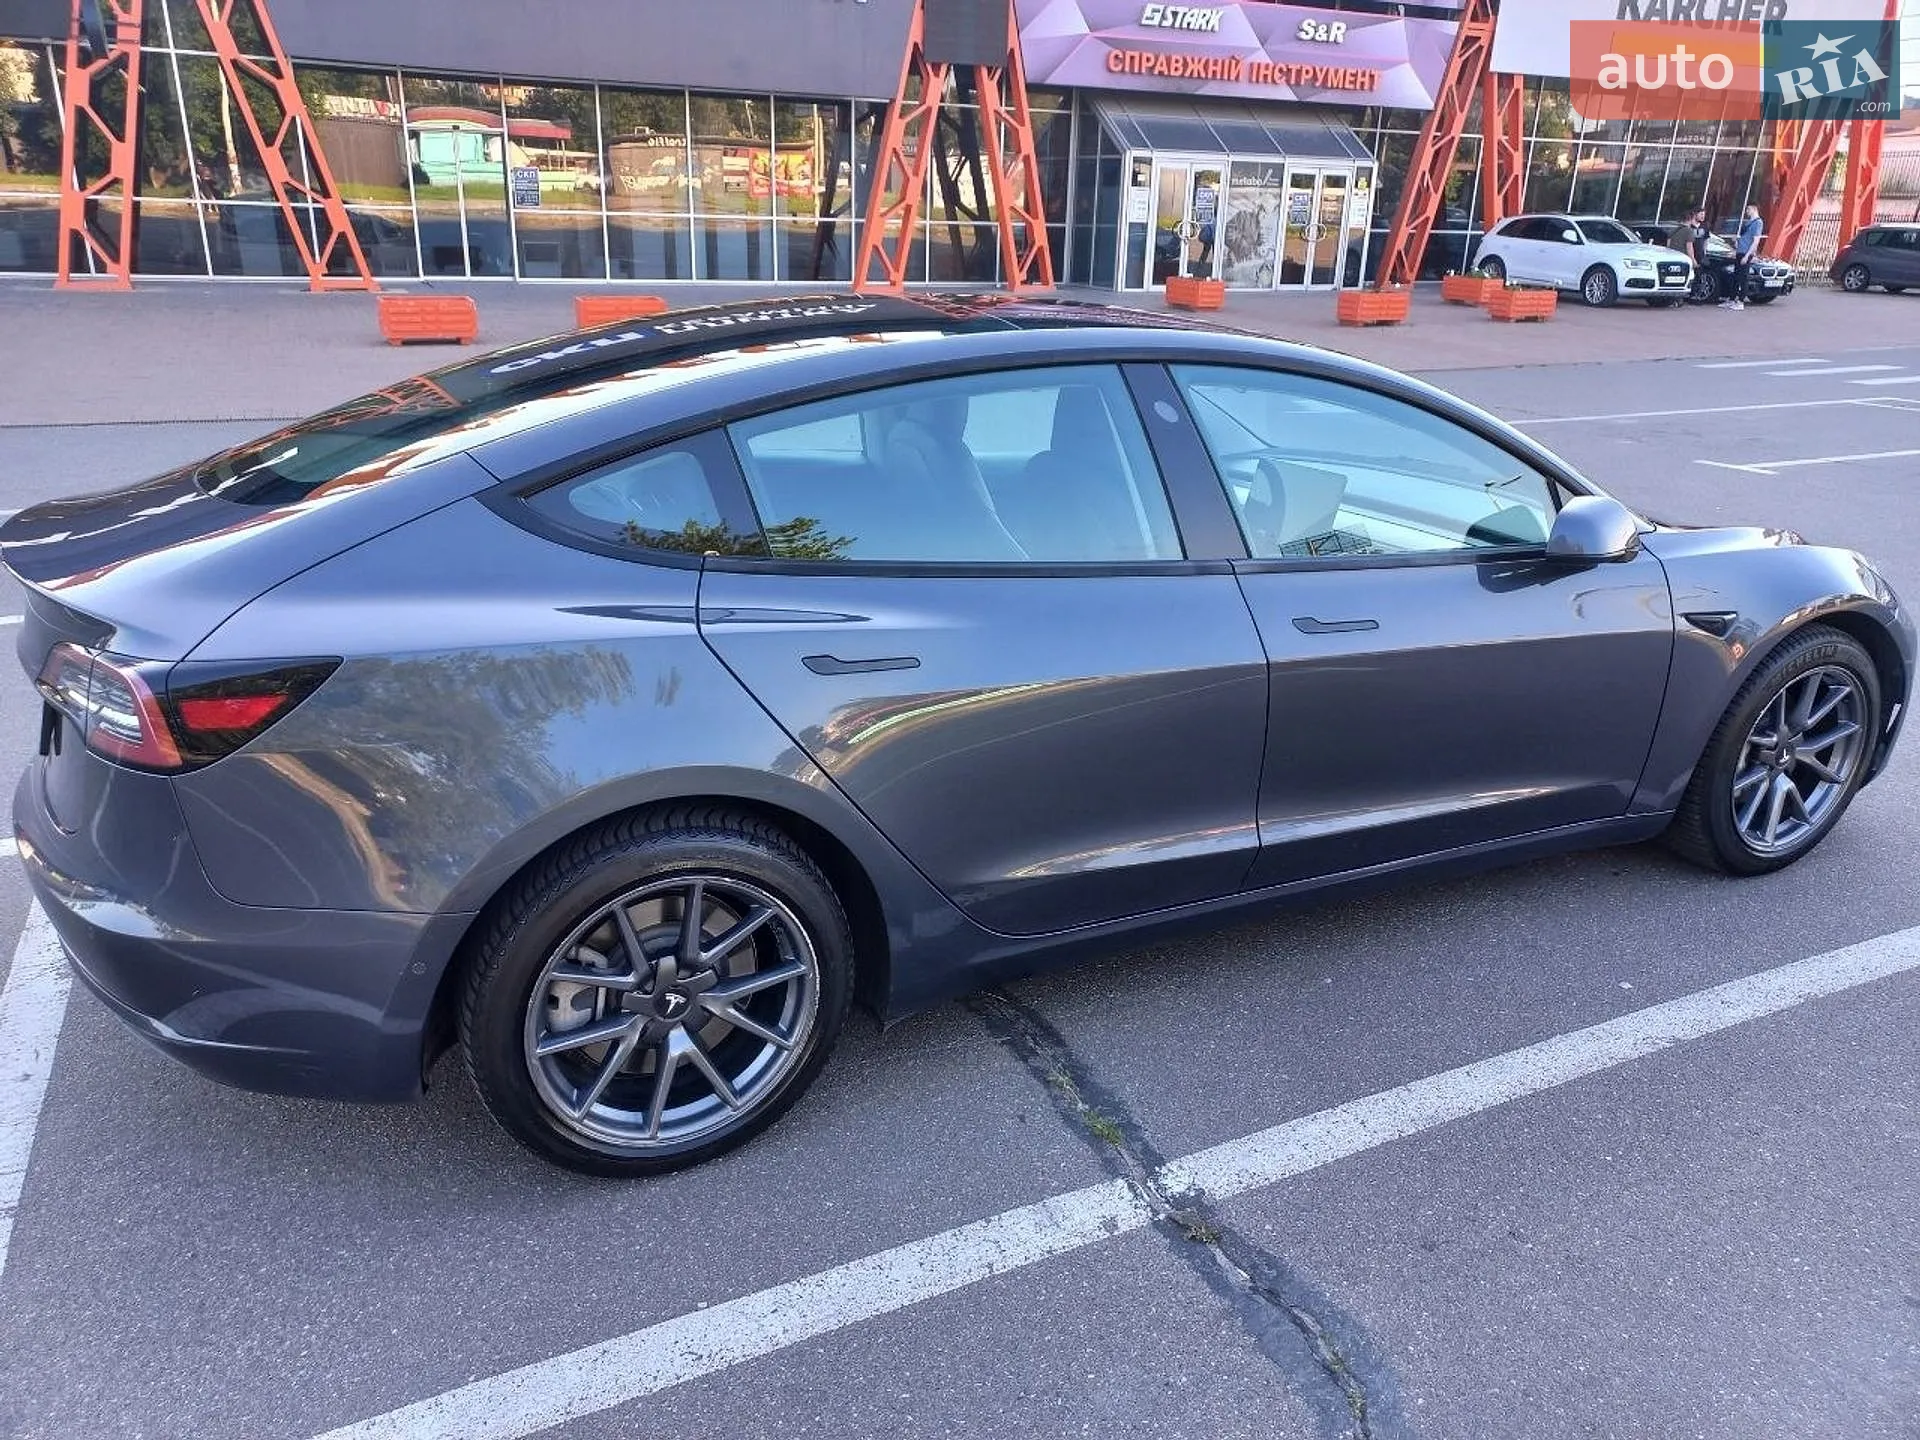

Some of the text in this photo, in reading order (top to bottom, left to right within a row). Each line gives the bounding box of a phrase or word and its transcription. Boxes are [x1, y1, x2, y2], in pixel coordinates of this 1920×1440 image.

[1299, 18, 1347, 43] S&R
[1107, 48, 1382, 92] СПРАВЖНІЙ ІНСТРУМЕНТ
